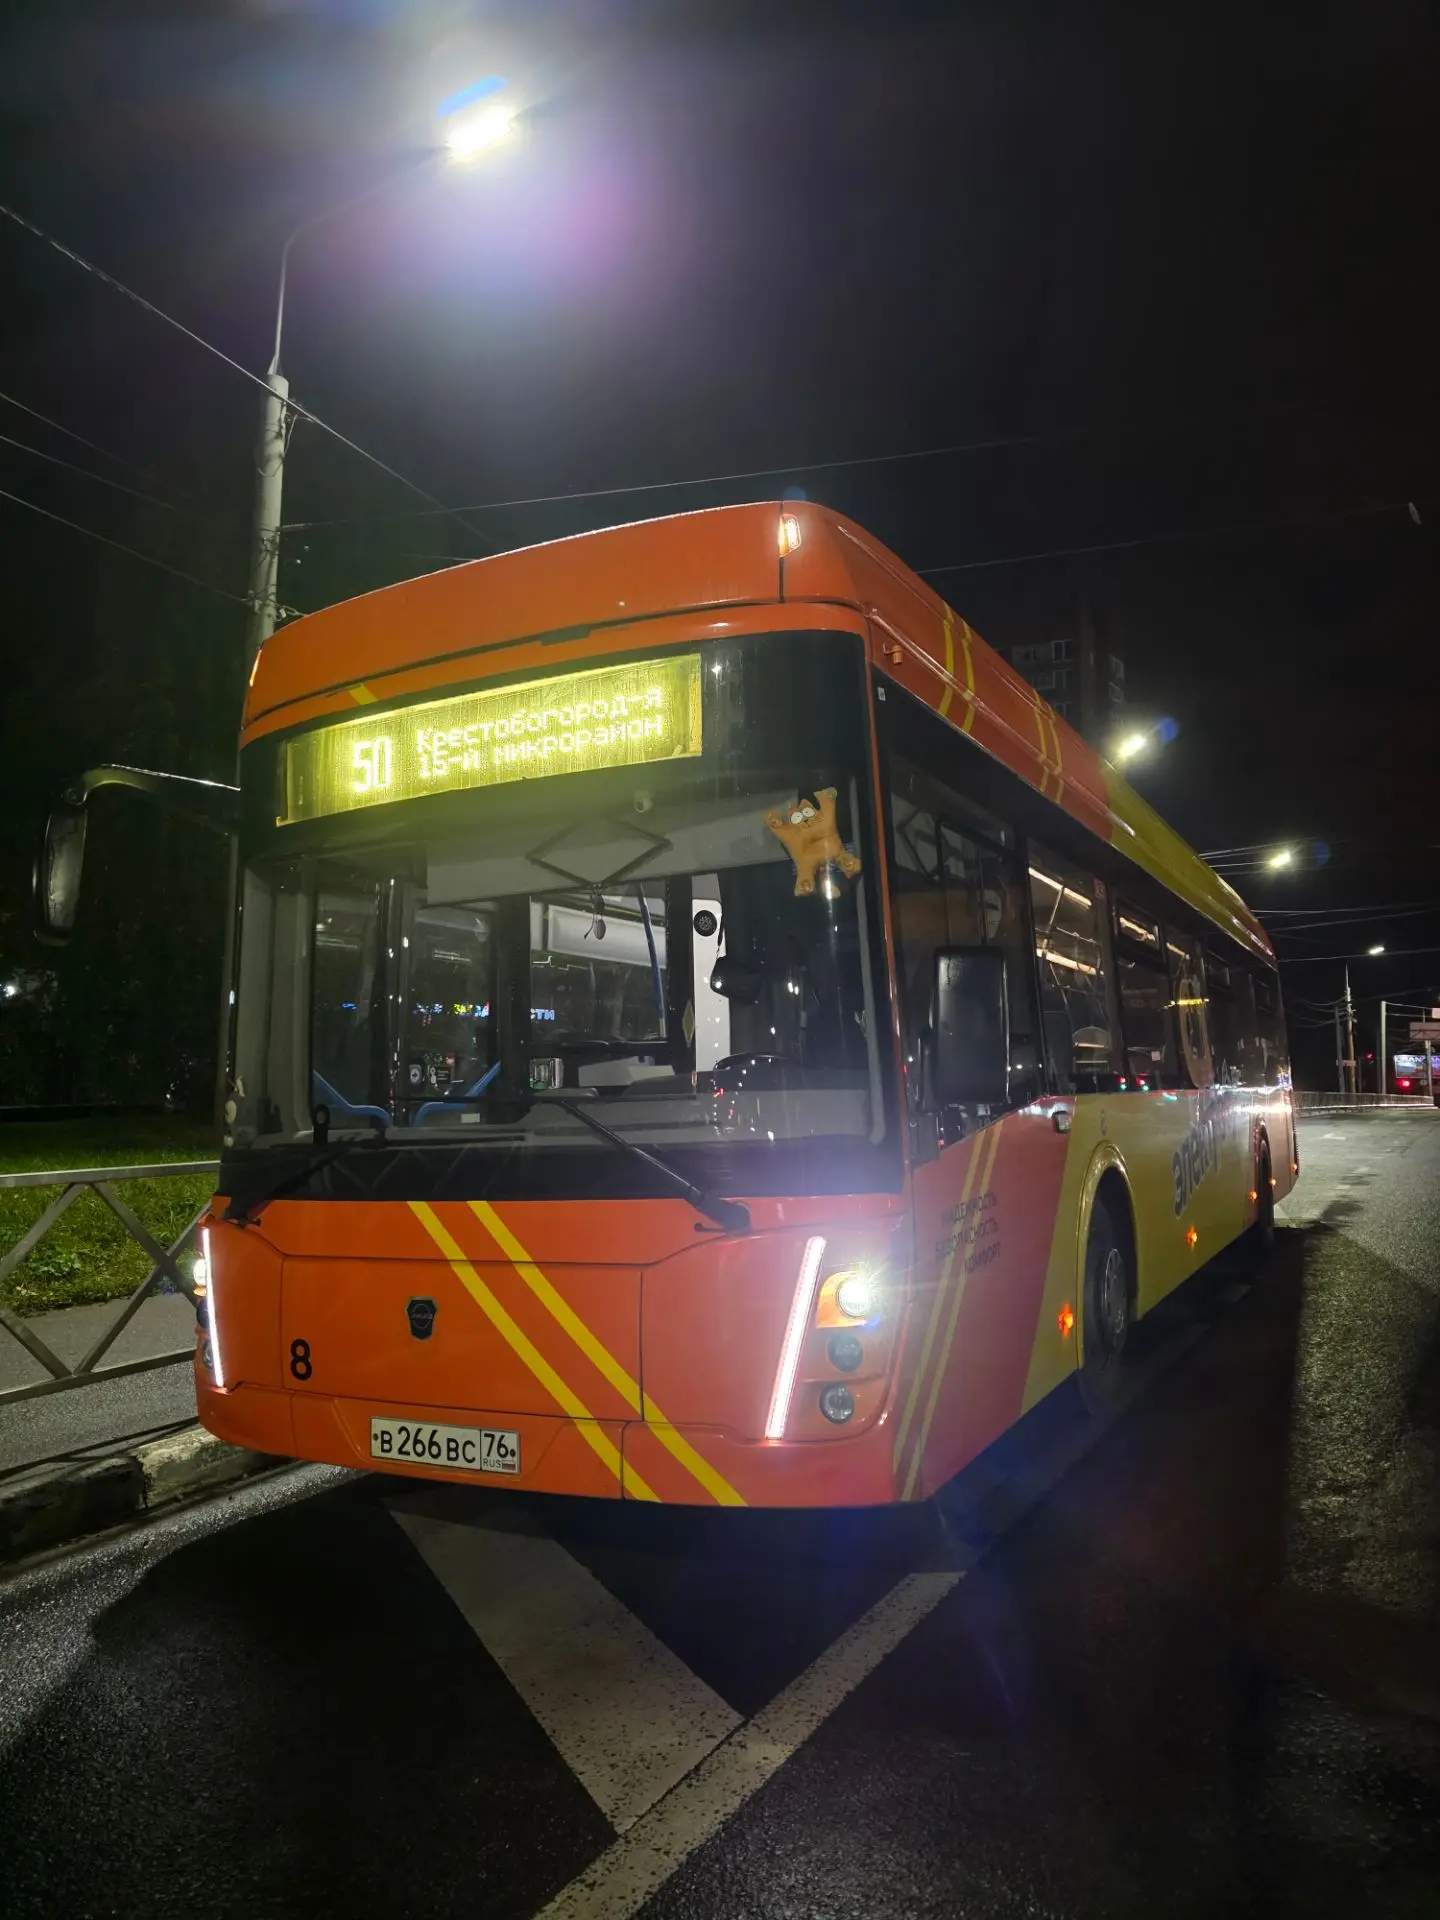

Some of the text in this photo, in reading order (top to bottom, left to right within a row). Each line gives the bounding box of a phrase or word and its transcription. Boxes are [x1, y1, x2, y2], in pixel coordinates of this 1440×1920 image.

[417, 688, 662, 752] Крестобогород-я
[353, 736, 392, 792] 50
[418, 714, 662, 779] 15-й микрорайон
[290, 1338, 312, 1381] 8
[483, 1432, 509, 1459] 76
[483, 1458, 501, 1468] RUS
